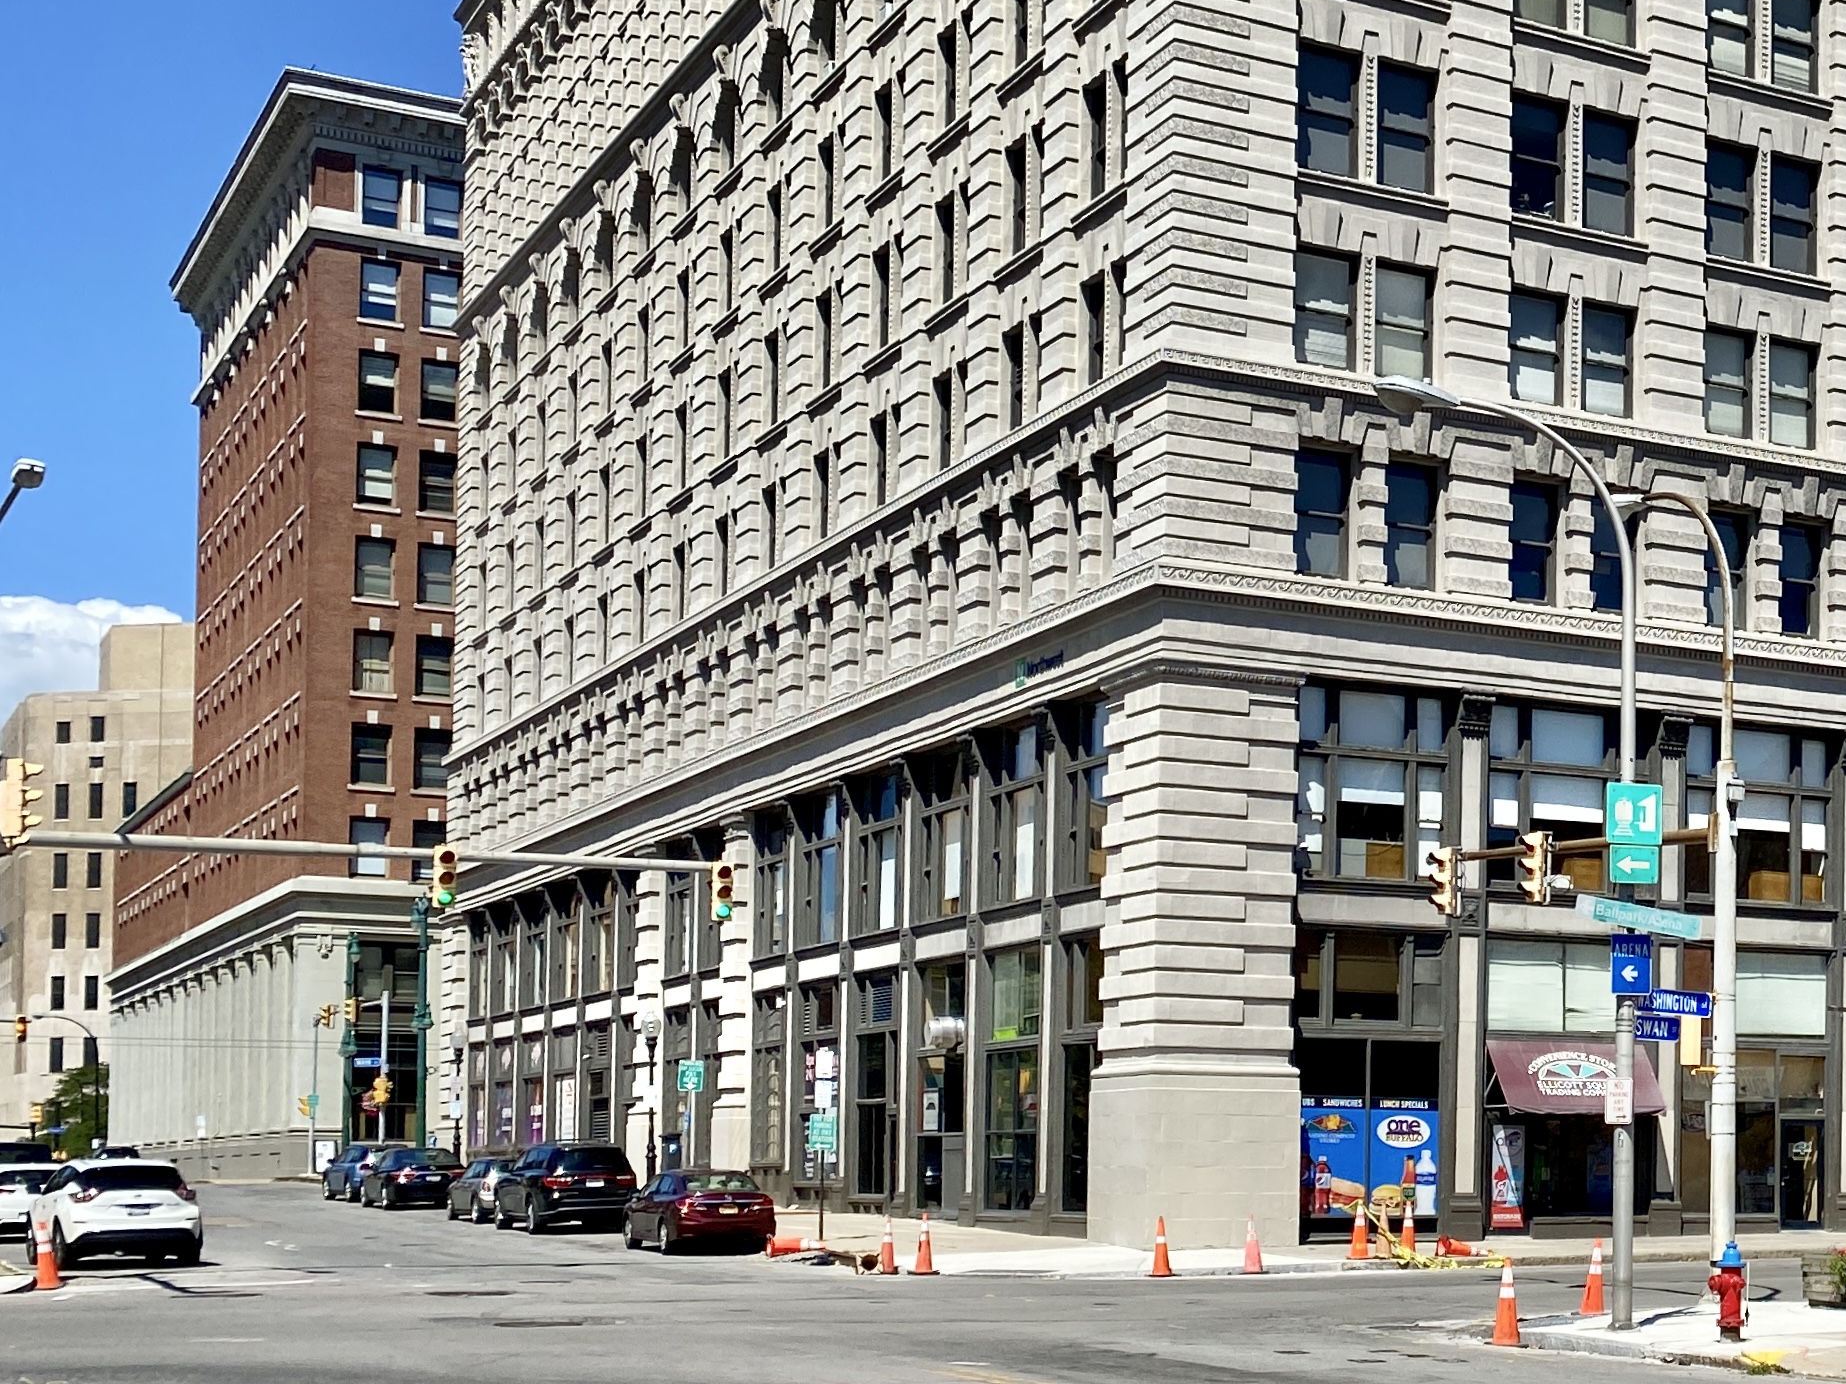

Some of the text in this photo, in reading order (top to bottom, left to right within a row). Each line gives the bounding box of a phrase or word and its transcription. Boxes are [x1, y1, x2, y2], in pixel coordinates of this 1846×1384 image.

[1614, 943, 1649, 957] ARENA
[1638, 992, 1698, 1012] WASHINGTON
[1635, 1019, 1669, 1037] SWAN
[1527, 1052, 1587, 1074] CONVENIENCE
[1537, 1080, 1583, 1089] ELLICOTT
[1323, 1099, 1362, 1107] SANDWICHES
[1380, 1100, 1429, 1109] LUNCH SPECIALS
[1387, 1119, 1420, 1133] one
[1386, 1133, 1423, 1142] BUFFALO
